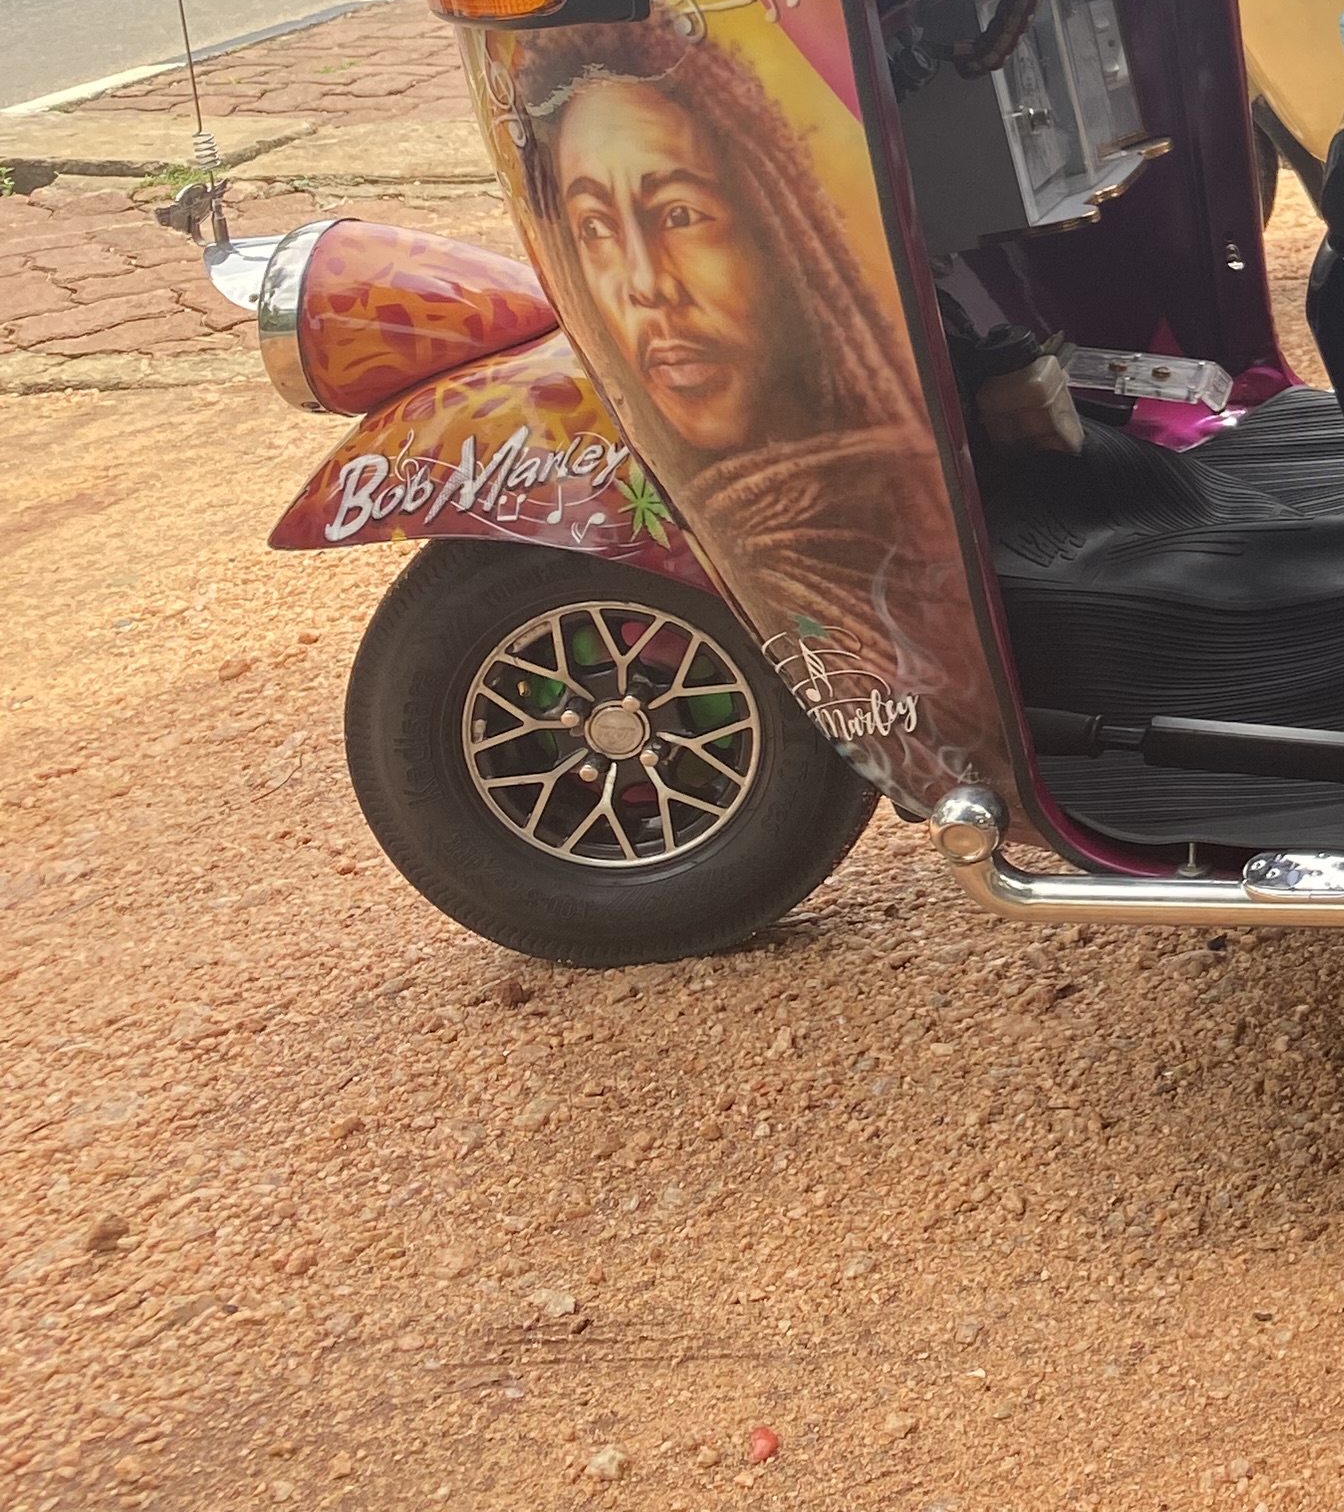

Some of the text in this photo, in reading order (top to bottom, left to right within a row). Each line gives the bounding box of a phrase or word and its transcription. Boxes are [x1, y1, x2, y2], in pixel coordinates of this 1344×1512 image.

[325, 425, 629, 541] Bob Marley
[815, 688, 919, 742] Marley
